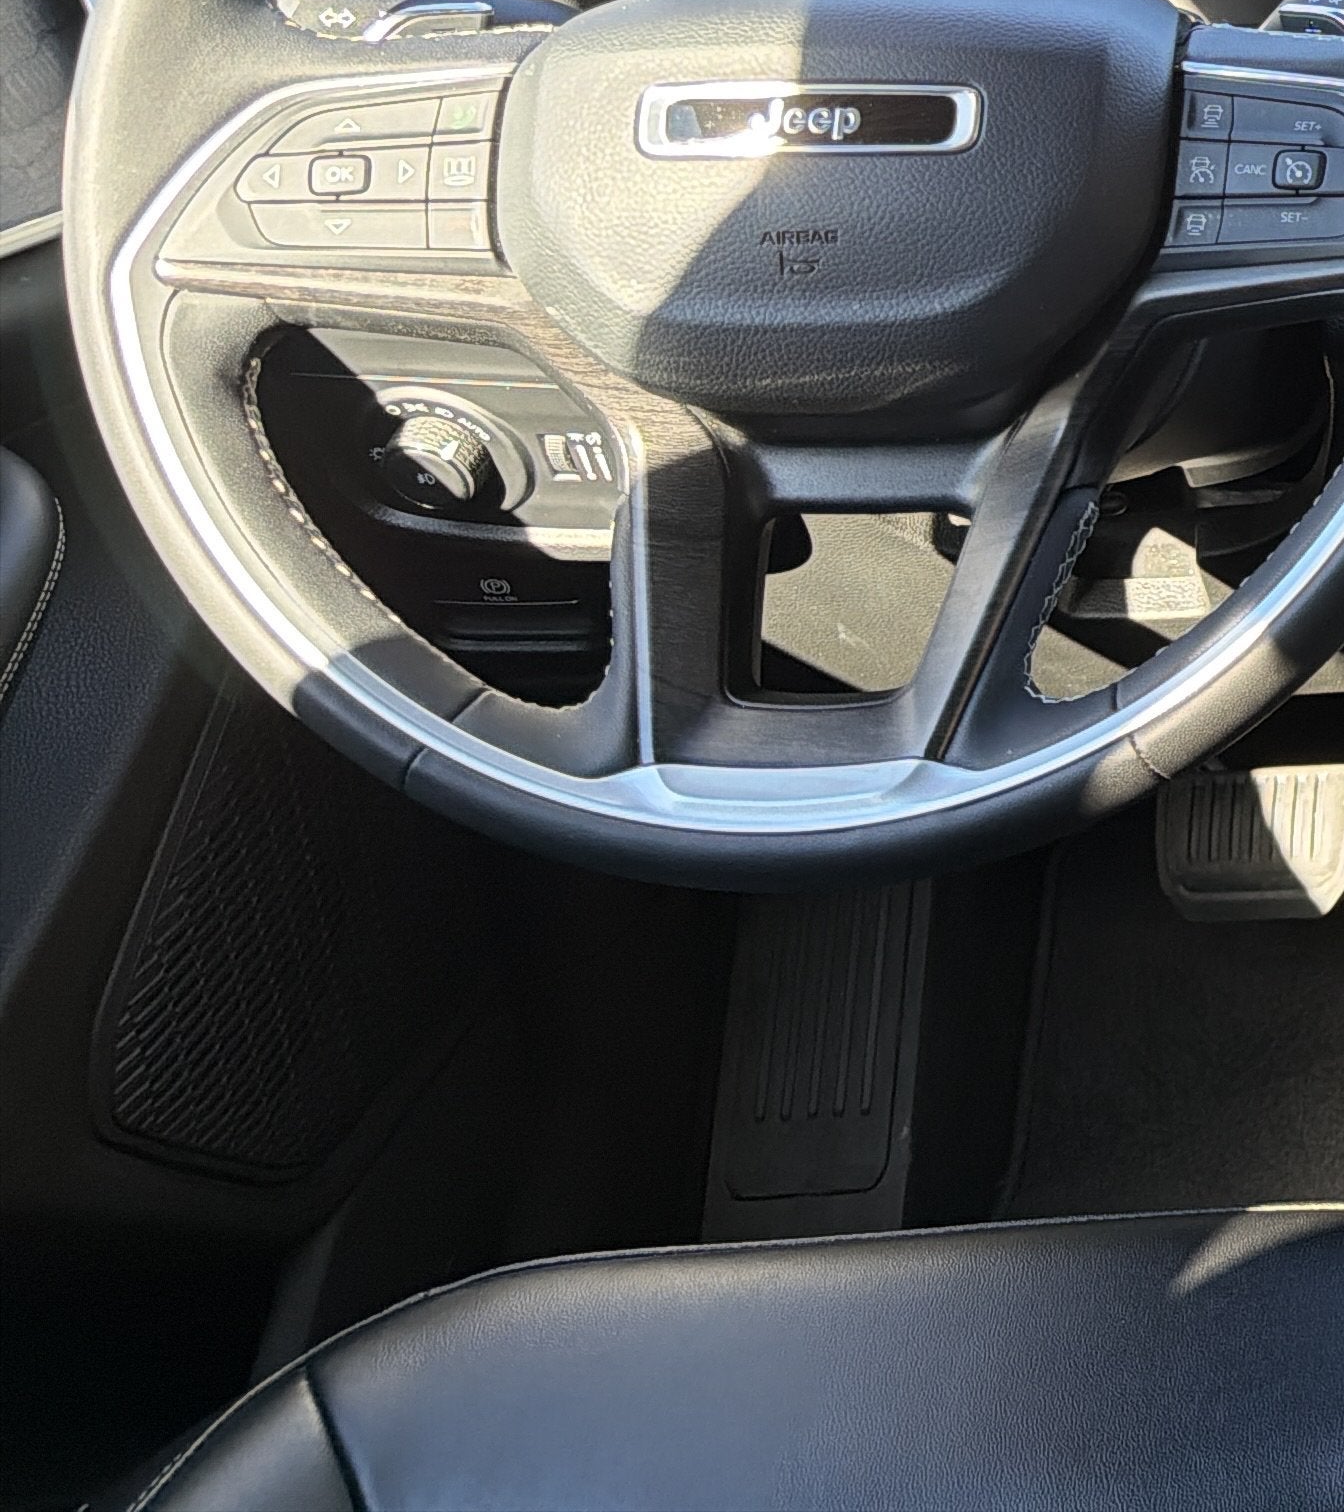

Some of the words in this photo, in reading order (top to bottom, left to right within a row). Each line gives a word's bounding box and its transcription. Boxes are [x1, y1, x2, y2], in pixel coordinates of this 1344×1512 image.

[749, 97, 862, 141] Jeep
[1294, 121, 1322, 131] SET+
[325, 166, 354, 183] OK
[1234, 164, 1266, 175] CANC
[760, 229, 840, 246] AIRBAG
[457, 417, 491, 442] AUTO
